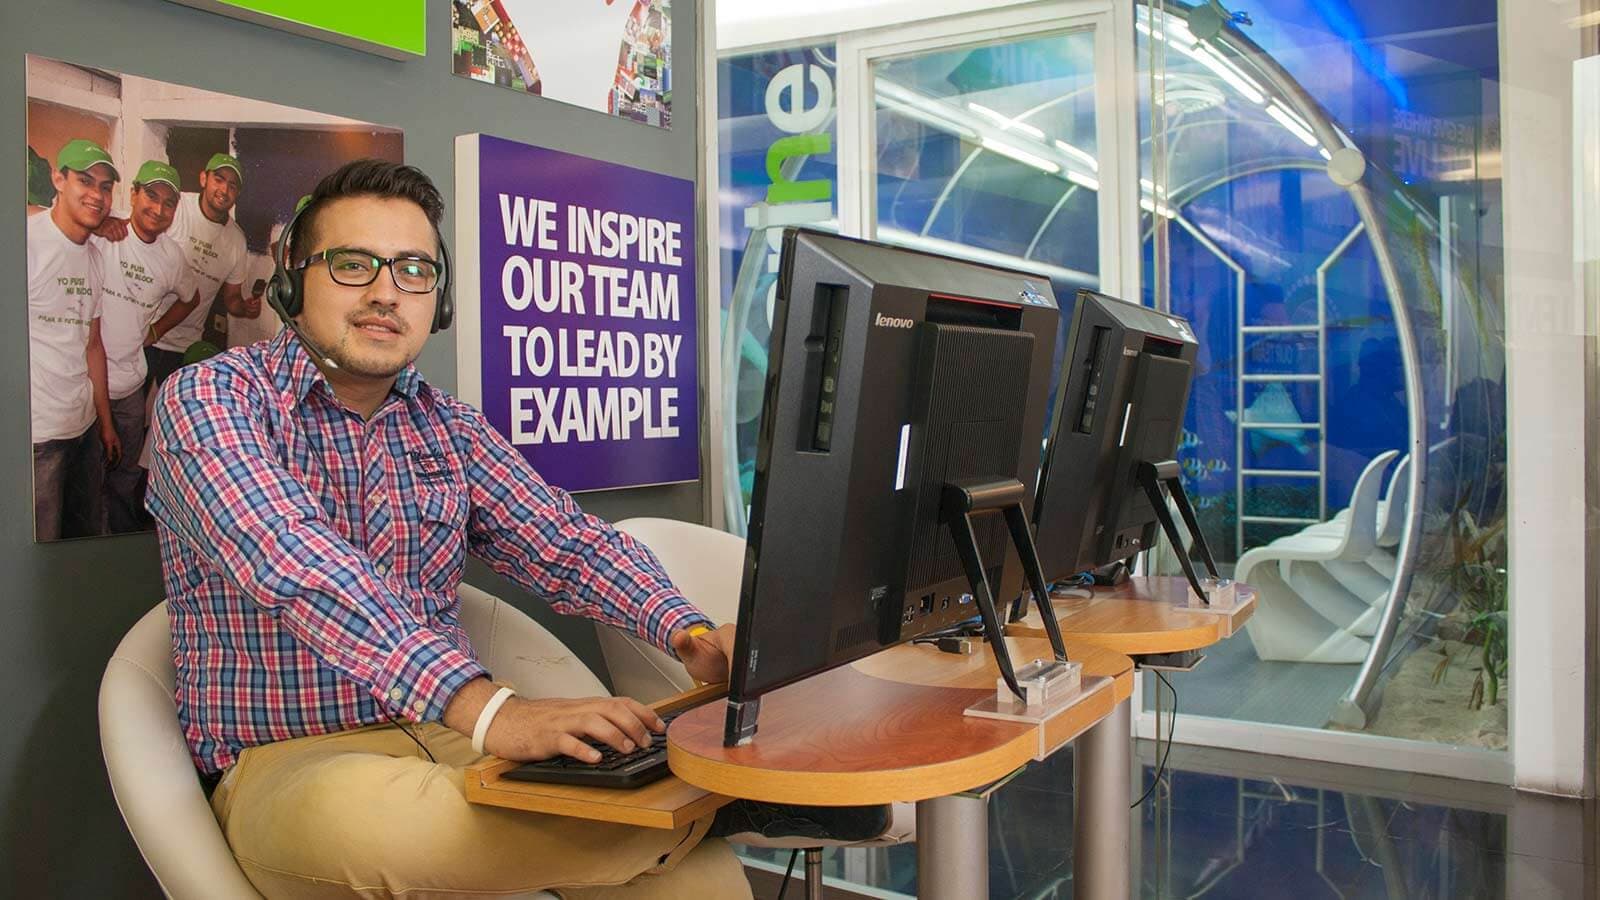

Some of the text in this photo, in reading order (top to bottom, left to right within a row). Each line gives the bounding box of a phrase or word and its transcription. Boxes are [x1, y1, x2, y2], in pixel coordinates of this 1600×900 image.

[498, 193, 682, 267] WE INSPIRE
[57, 277, 68, 286] YO
[502, 255, 680, 322] OUR TEAM
[875, 311, 914, 329] lenovo
[503, 324, 682, 379] TO LEAD BY
[510, 387, 680, 445] EXAMPLE
